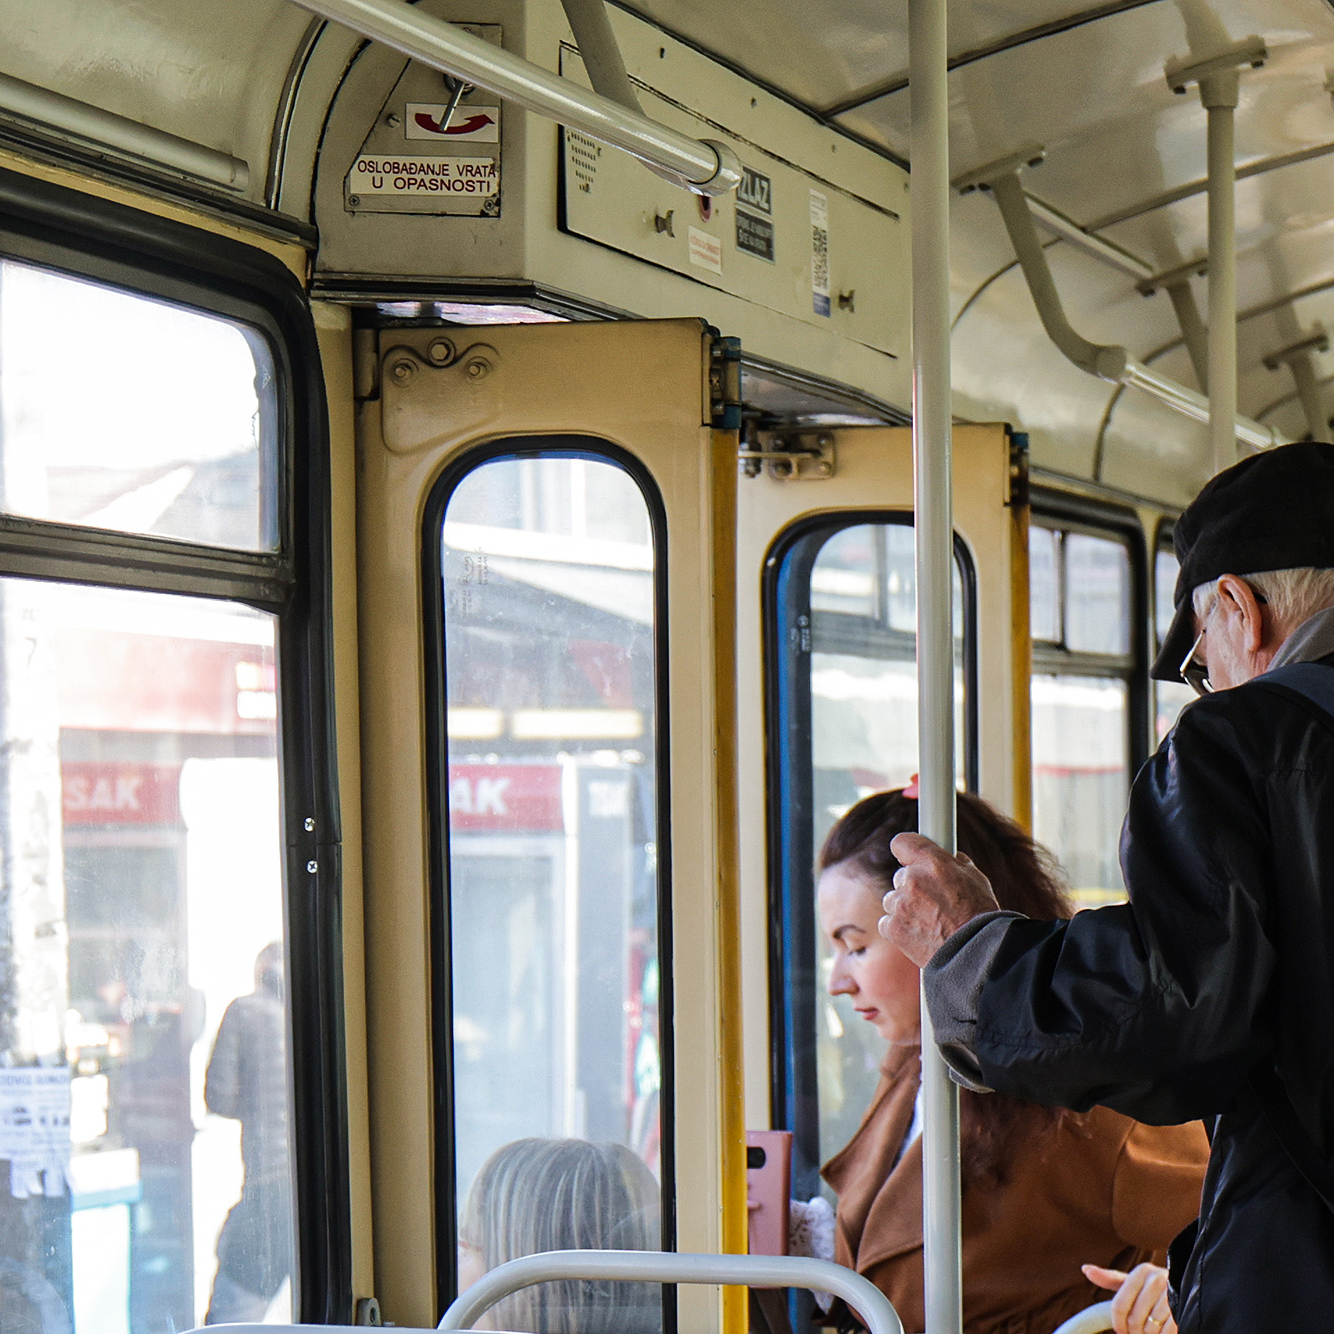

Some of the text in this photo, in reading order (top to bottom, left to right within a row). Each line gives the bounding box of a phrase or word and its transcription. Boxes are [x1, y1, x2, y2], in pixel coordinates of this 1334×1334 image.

[357, 160, 496, 178] OSLOBAĐANJE VRATA
[371, 176, 491, 193] U OPASNOSTI
[64, 776, 142, 810] SAK
[450, 777, 511, 815] AK
